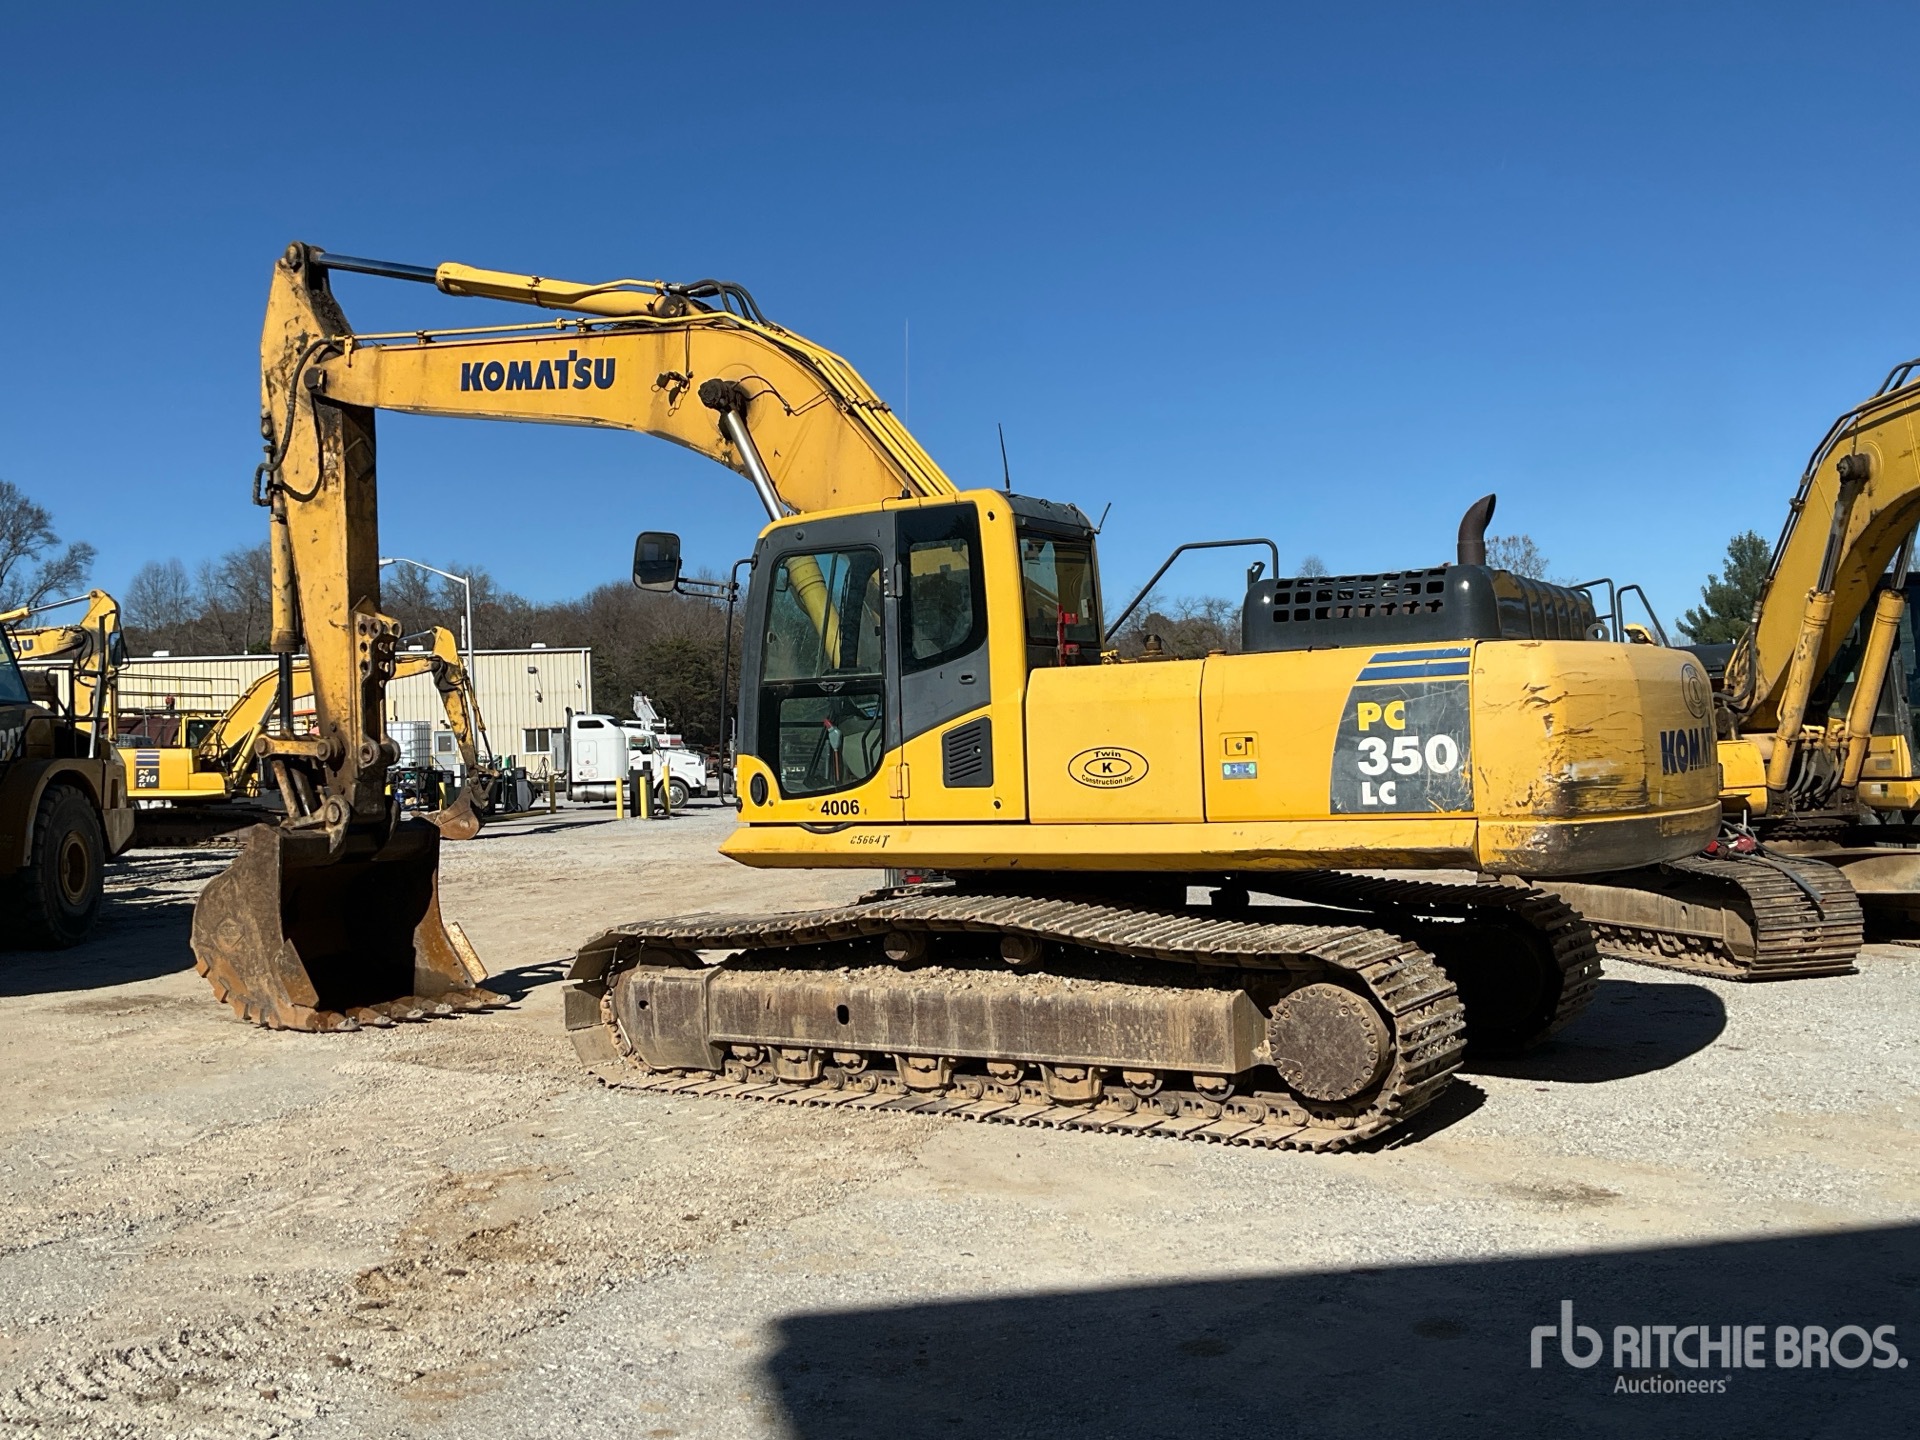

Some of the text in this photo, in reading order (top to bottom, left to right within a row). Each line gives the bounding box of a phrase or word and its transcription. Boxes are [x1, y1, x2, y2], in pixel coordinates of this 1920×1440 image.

[461, 350, 616, 391] KOMATSU
[1357, 702, 1406, 731] PC
[1094, 750, 1121, 758] Twin
[1357, 735, 1459, 776] 350
[1102, 762, 1113, 773] K
[138, 775, 157, 783] 210
[1082, 774, 1122, 786] Construction
[1362, 781, 1397, 805] LC
[820, 799, 860, 816] 4006
